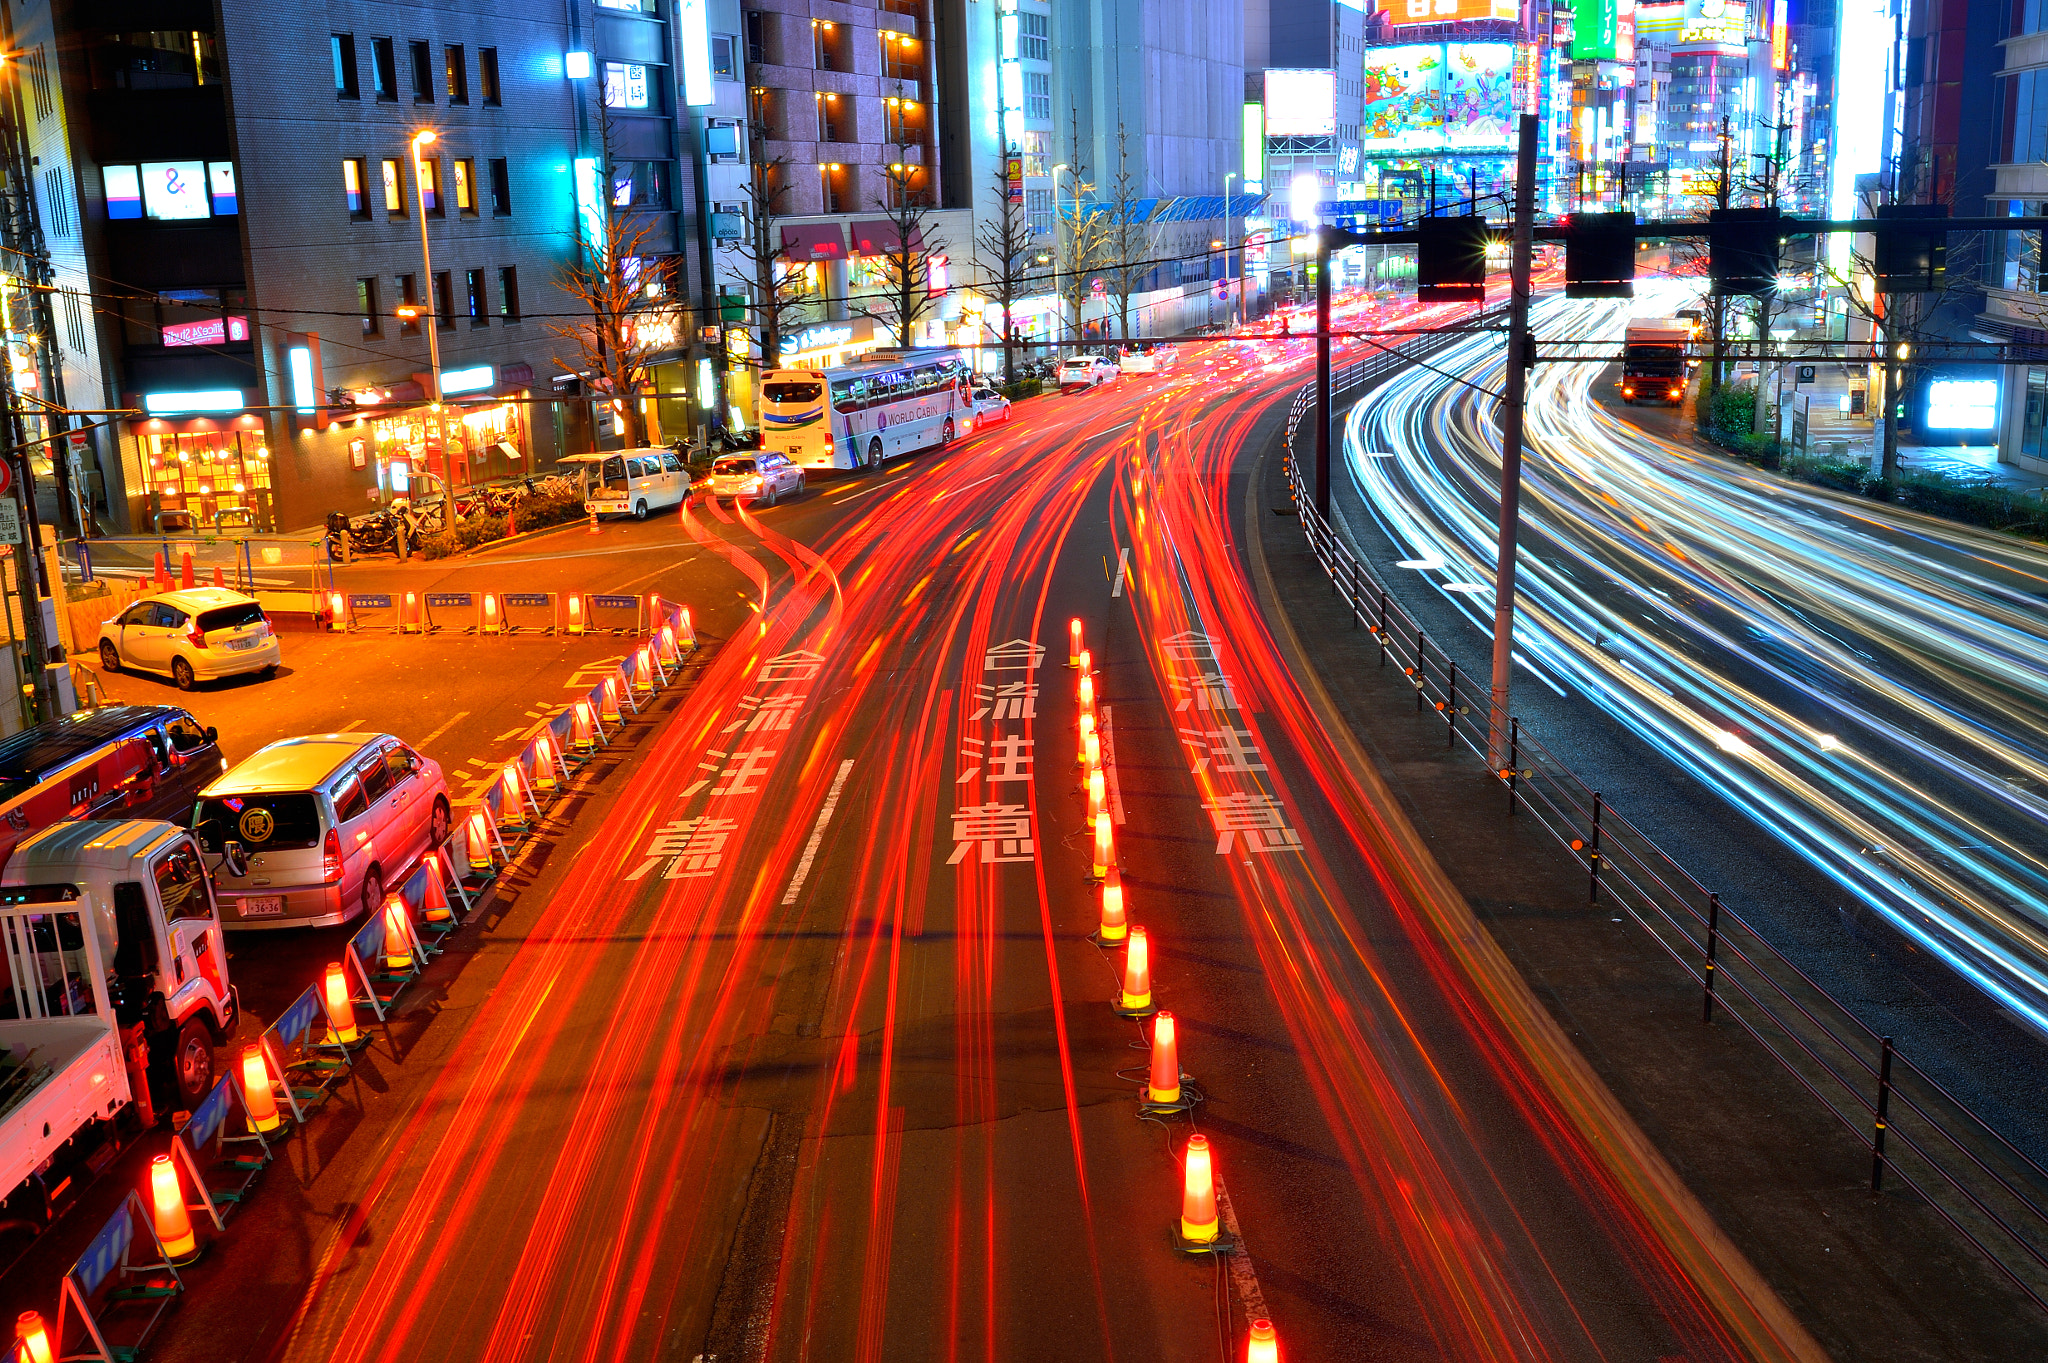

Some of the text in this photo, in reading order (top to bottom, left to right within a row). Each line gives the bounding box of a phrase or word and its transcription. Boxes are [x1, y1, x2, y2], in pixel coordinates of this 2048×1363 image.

[888, 405, 939, 427] WORLD CABIN
[945, 638, 1047, 866] 合流注意
[255, 903, 279, 913] 36-36
